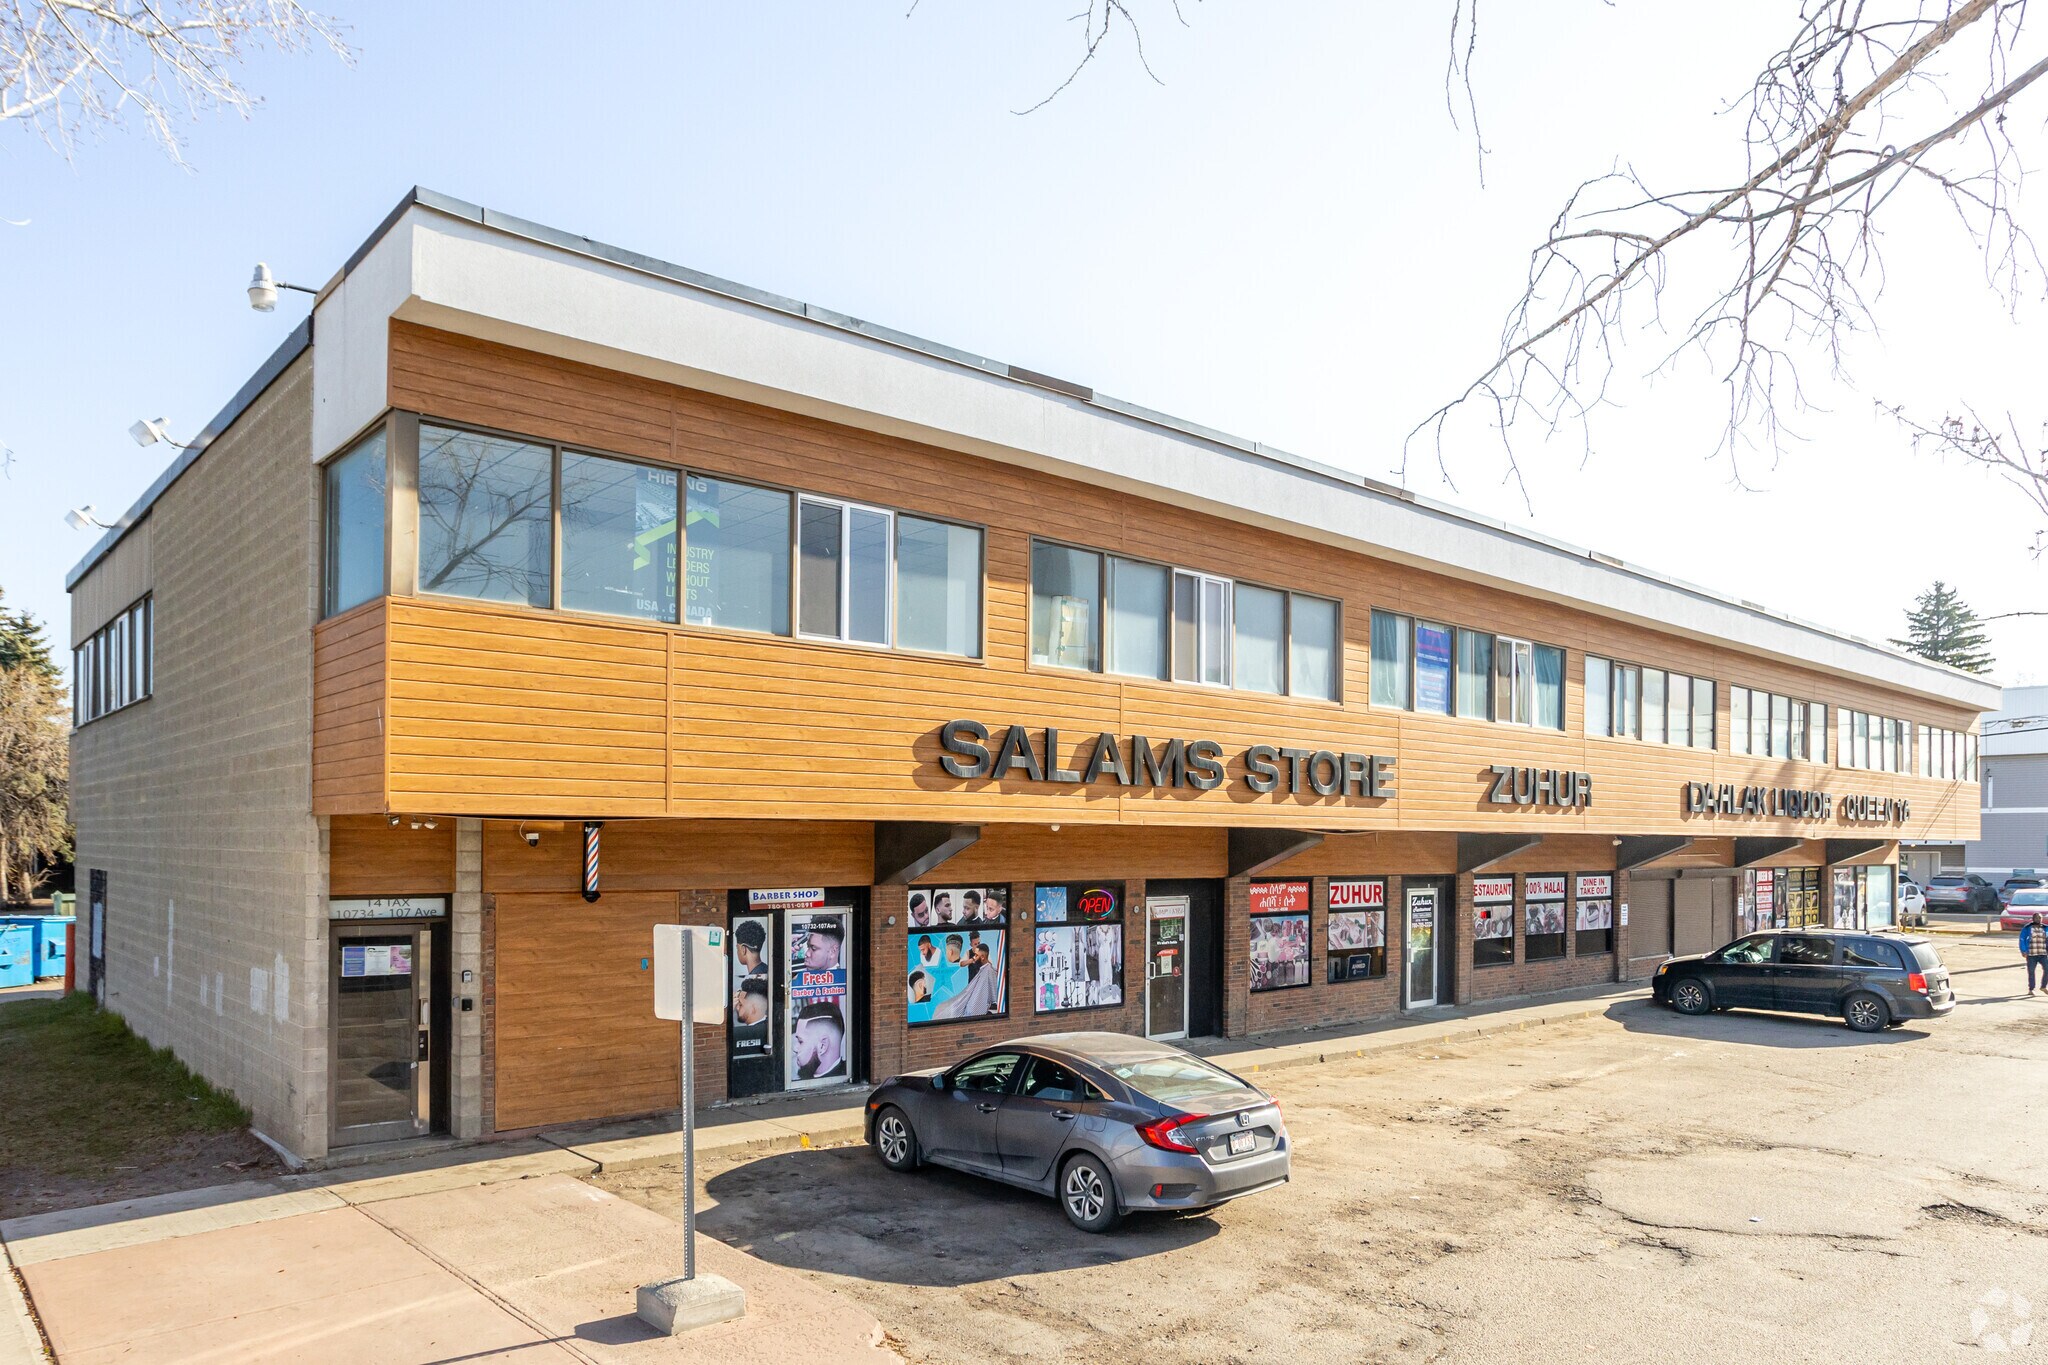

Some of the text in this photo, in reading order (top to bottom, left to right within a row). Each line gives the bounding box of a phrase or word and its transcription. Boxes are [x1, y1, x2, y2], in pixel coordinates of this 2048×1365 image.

[648, 471, 707, 493] HIRNG
[667, 542, 714, 560] INUSTRY
[666, 557, 710, 573] LEDERS
[666, 571, 710, 587] WHOUT
[665, 585, 697, 600] LITS
[636, 598, 659, 612] USA
[669, 603, 713, 618] CNADA
[939, 718, 1396, 798] SALAMS STORE
[1490, 765, 1592, 807] ZUHUR
[1687, 781, 1831, 819] DAHLAK LIQUOR
[1845, 794, 1893, 821] QUEEN
[1473, 883, 1512, 896] ESTAURANT
[1525, 881, 1565, 894] 100% HALAL
[1582, 878, 1605, 886] DINE IN
[753, 890, 819, 900] BARBER SHOP
[1330, 884, 1383, 905] ZUHUR
[1580, 886, 1608, 895] TAKE OUT
[387, 898, 410, 907] TAX
[1079, 897, 1111, 913] OPEN
[336, 909, 375, 918] 10734
[389, 908, 411, 917] 107
[414, 907, 437, 917] Ave
[802, 971, 834, 985] Fresh
[792, 988, 814, 997] Barber
[822, 986, 845, 996] Fashion
[736, 1038, 761, 1048] FRESH
